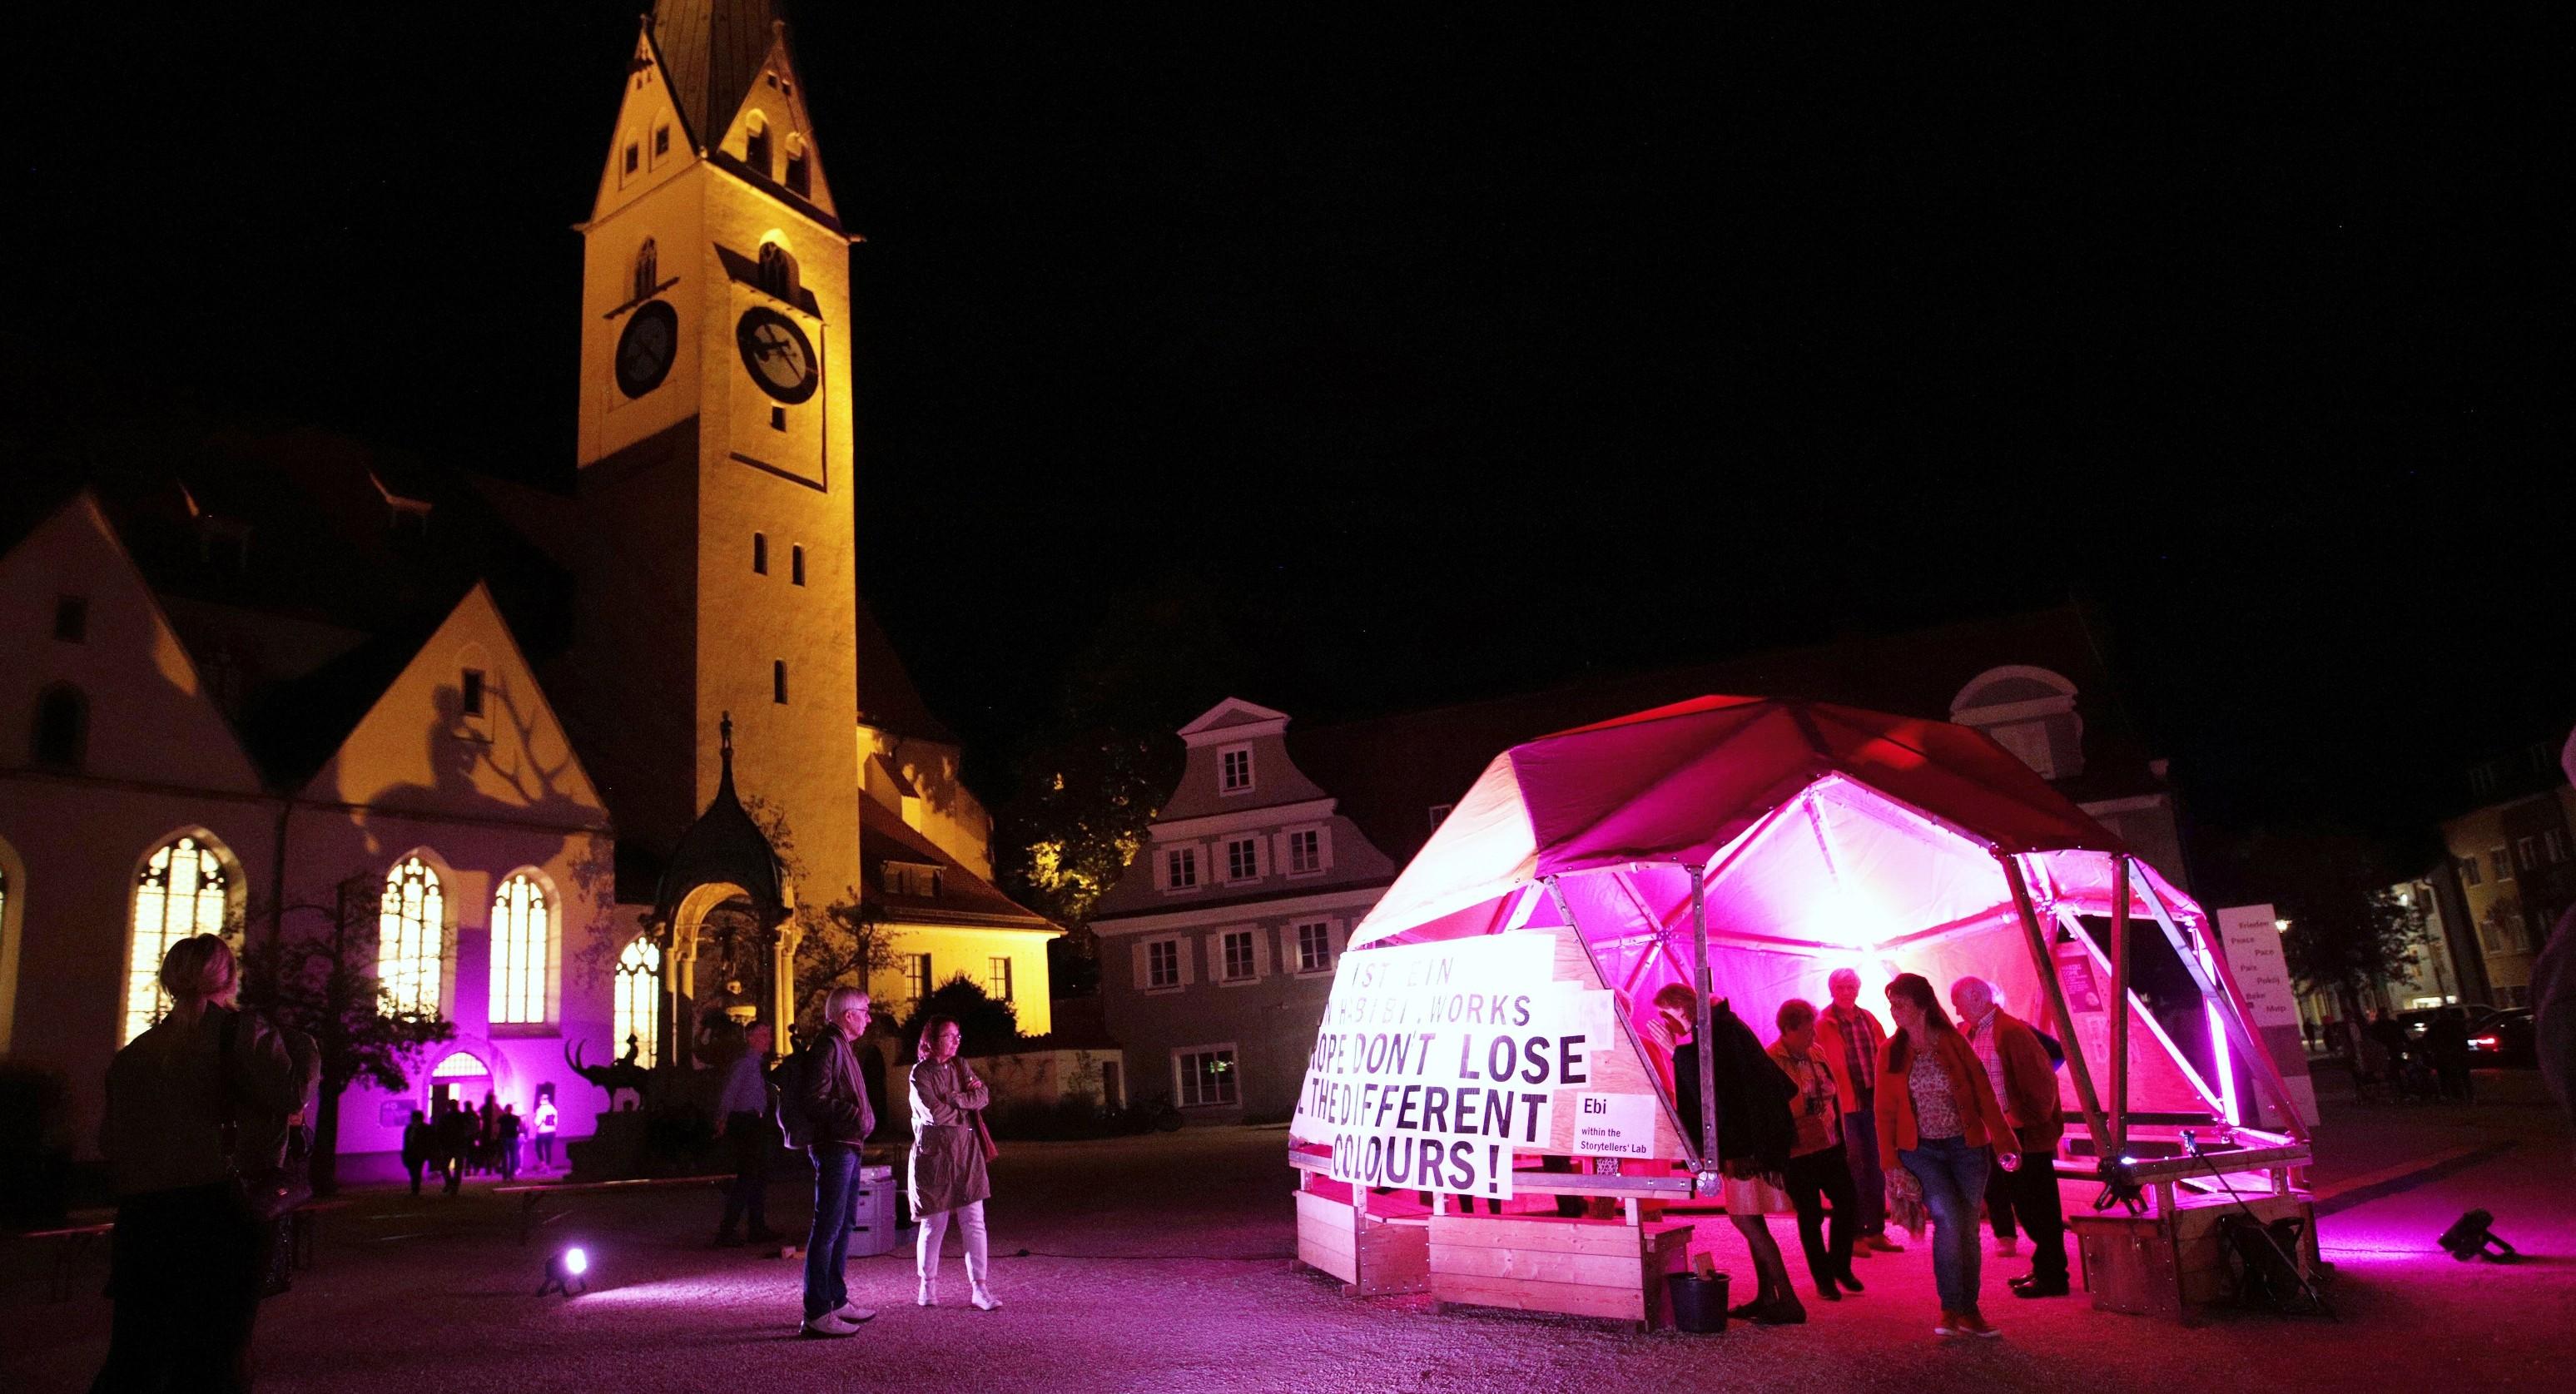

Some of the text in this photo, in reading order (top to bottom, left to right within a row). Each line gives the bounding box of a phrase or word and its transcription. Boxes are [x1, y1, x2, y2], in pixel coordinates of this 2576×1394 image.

[1353, 1029, 1436, 1076] DON'T
[1459, 1034, 1587, 1085] LOSE
[1312, 1078, 1338, 1124] THE
[1340, 1083, 1547, 1143] DIFFERENT
[1584, 1098, 1606, 1114] Ebi
[1581, 1127, 1621, 1137] within the
[1581, 1140, 1646, 1153] Storytellers' Lab
